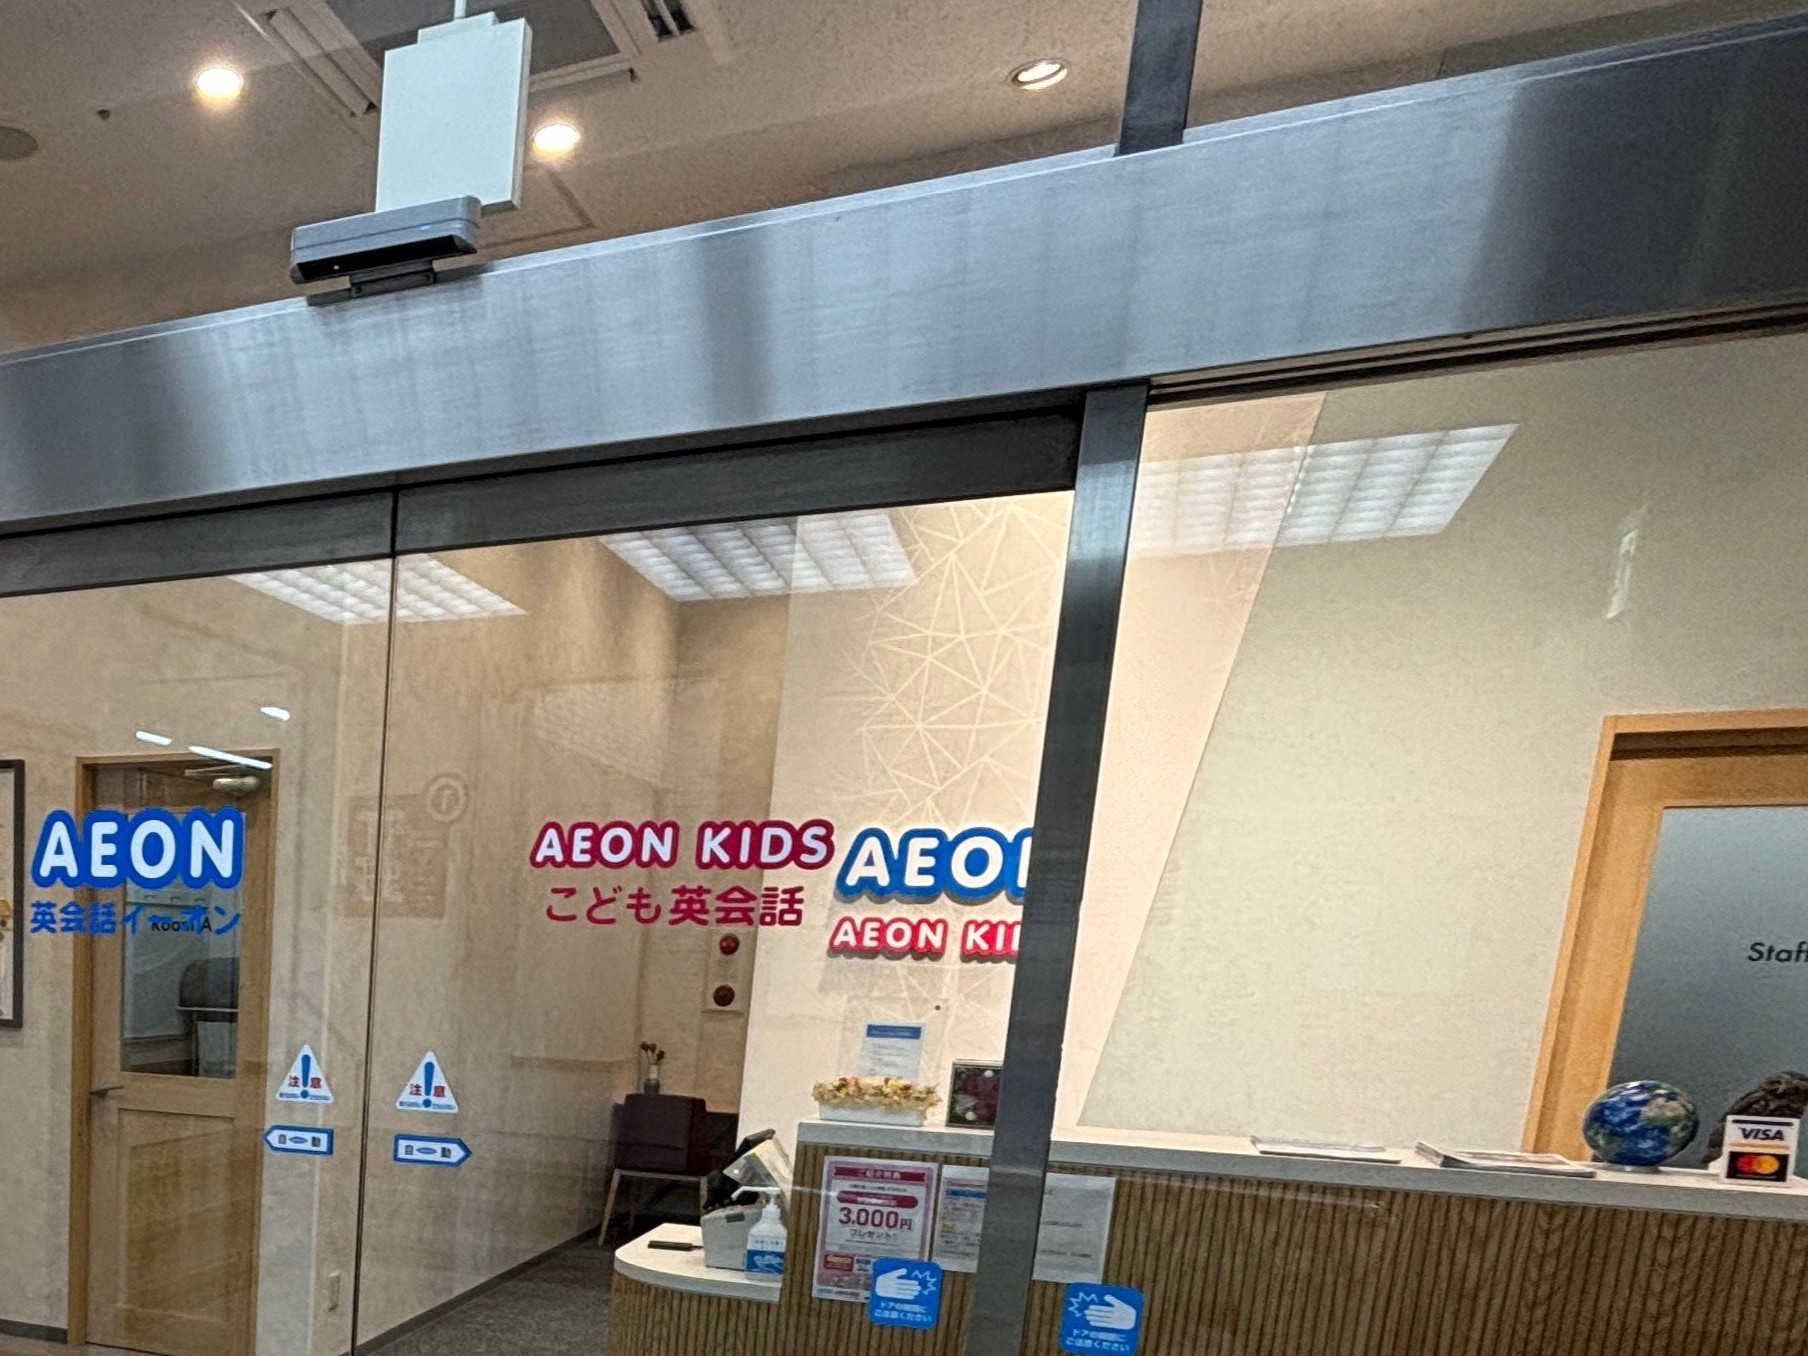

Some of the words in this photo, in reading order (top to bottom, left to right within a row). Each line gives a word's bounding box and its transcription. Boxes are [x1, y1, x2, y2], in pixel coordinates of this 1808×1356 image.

[32, 806, 244, 889] AEON
[530, 821, 679, 869] AEON
[695, 819, 834, 869] KIDS
[30, 900, 240, 935] 英会話イーオン
[545, 885, 805, 927] こども英会話
[830, 916, 948, 956] AEON
[961, 919, 1024, 961] KI
[1740, 1127, 1785, 1142] VISA
